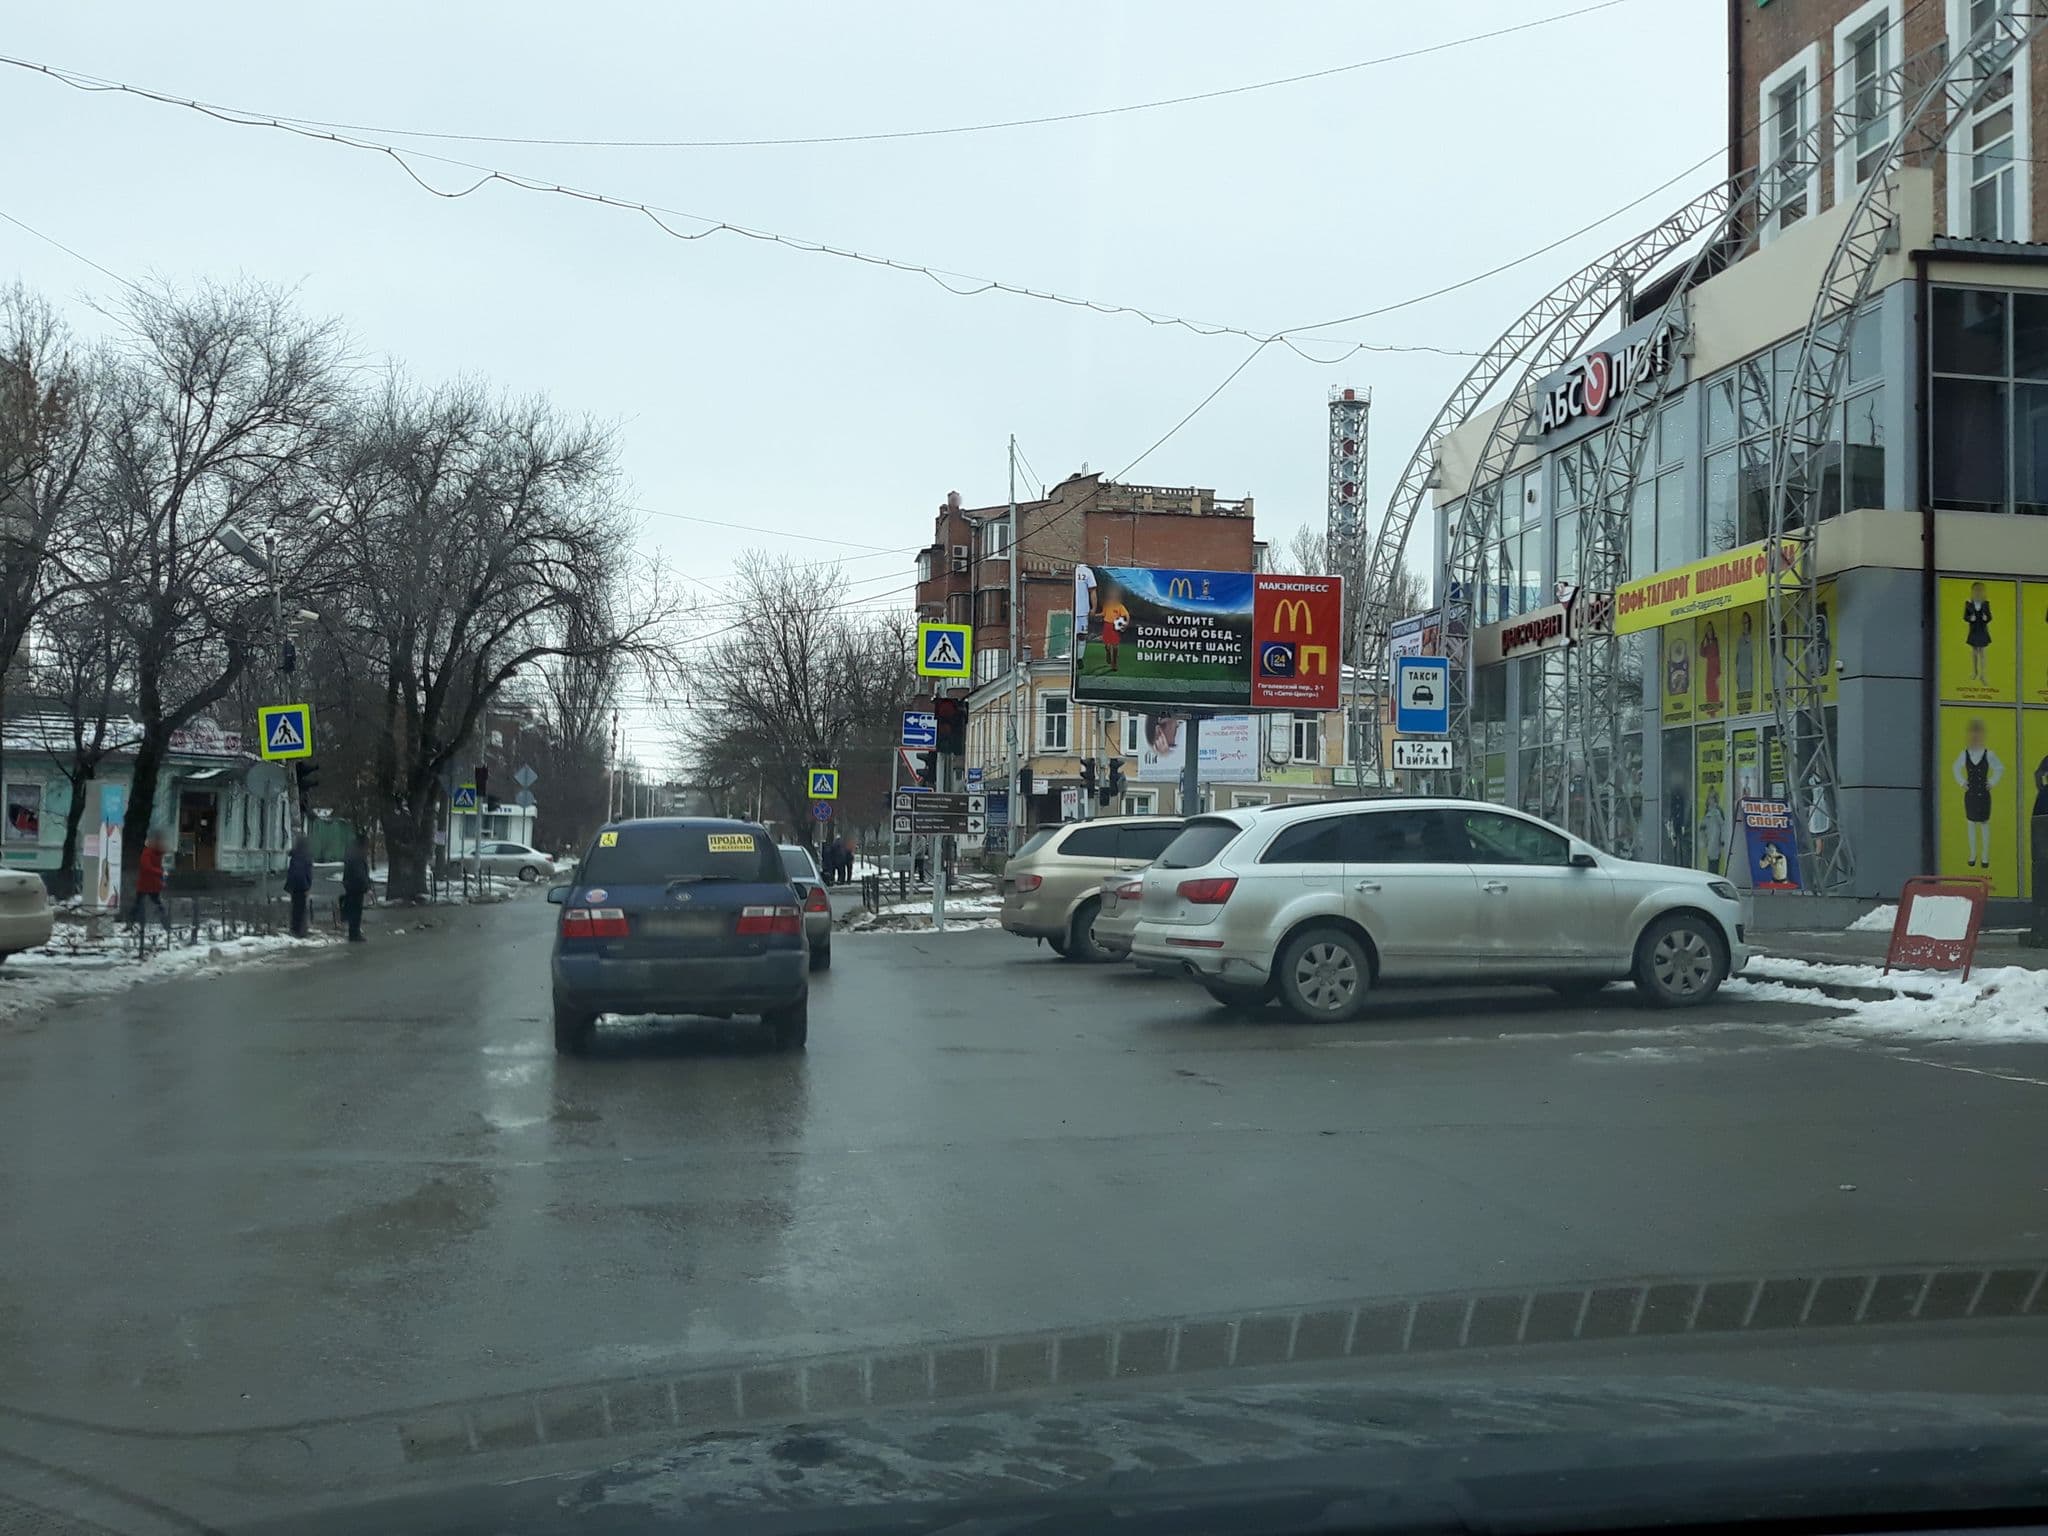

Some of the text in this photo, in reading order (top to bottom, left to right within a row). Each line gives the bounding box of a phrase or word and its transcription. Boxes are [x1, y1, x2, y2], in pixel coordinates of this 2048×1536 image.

[1540, 326, 1669, 435] АБСОЛЮТ
[1695, 555, 1753, 594] ШКОЛЬНАЯ
[1258, 581, 1330, 593] МАКЭКСПРЕСС
[1167, 615, 1215, 627] КУПИТЕ
[1137, 627, 1198, 639] БОЛЬШОЙ
[1201, 630, 1233, 641] ОБЕД
[1137, 639, 1241, 653] ПОЛУЧИТЕ ШАНС
[1136, 652, 1199, 664] ВЫИГРАТЬ
[1274, 654, 1286, 664] 24
[1408, 671, 1438, 681] ТАКСИ
[1411, 743, 1424, 754] 12
[1747, 815, 1788, 828] СПОРТ
[710, 836, 752, 845] ПРОДАЮ
